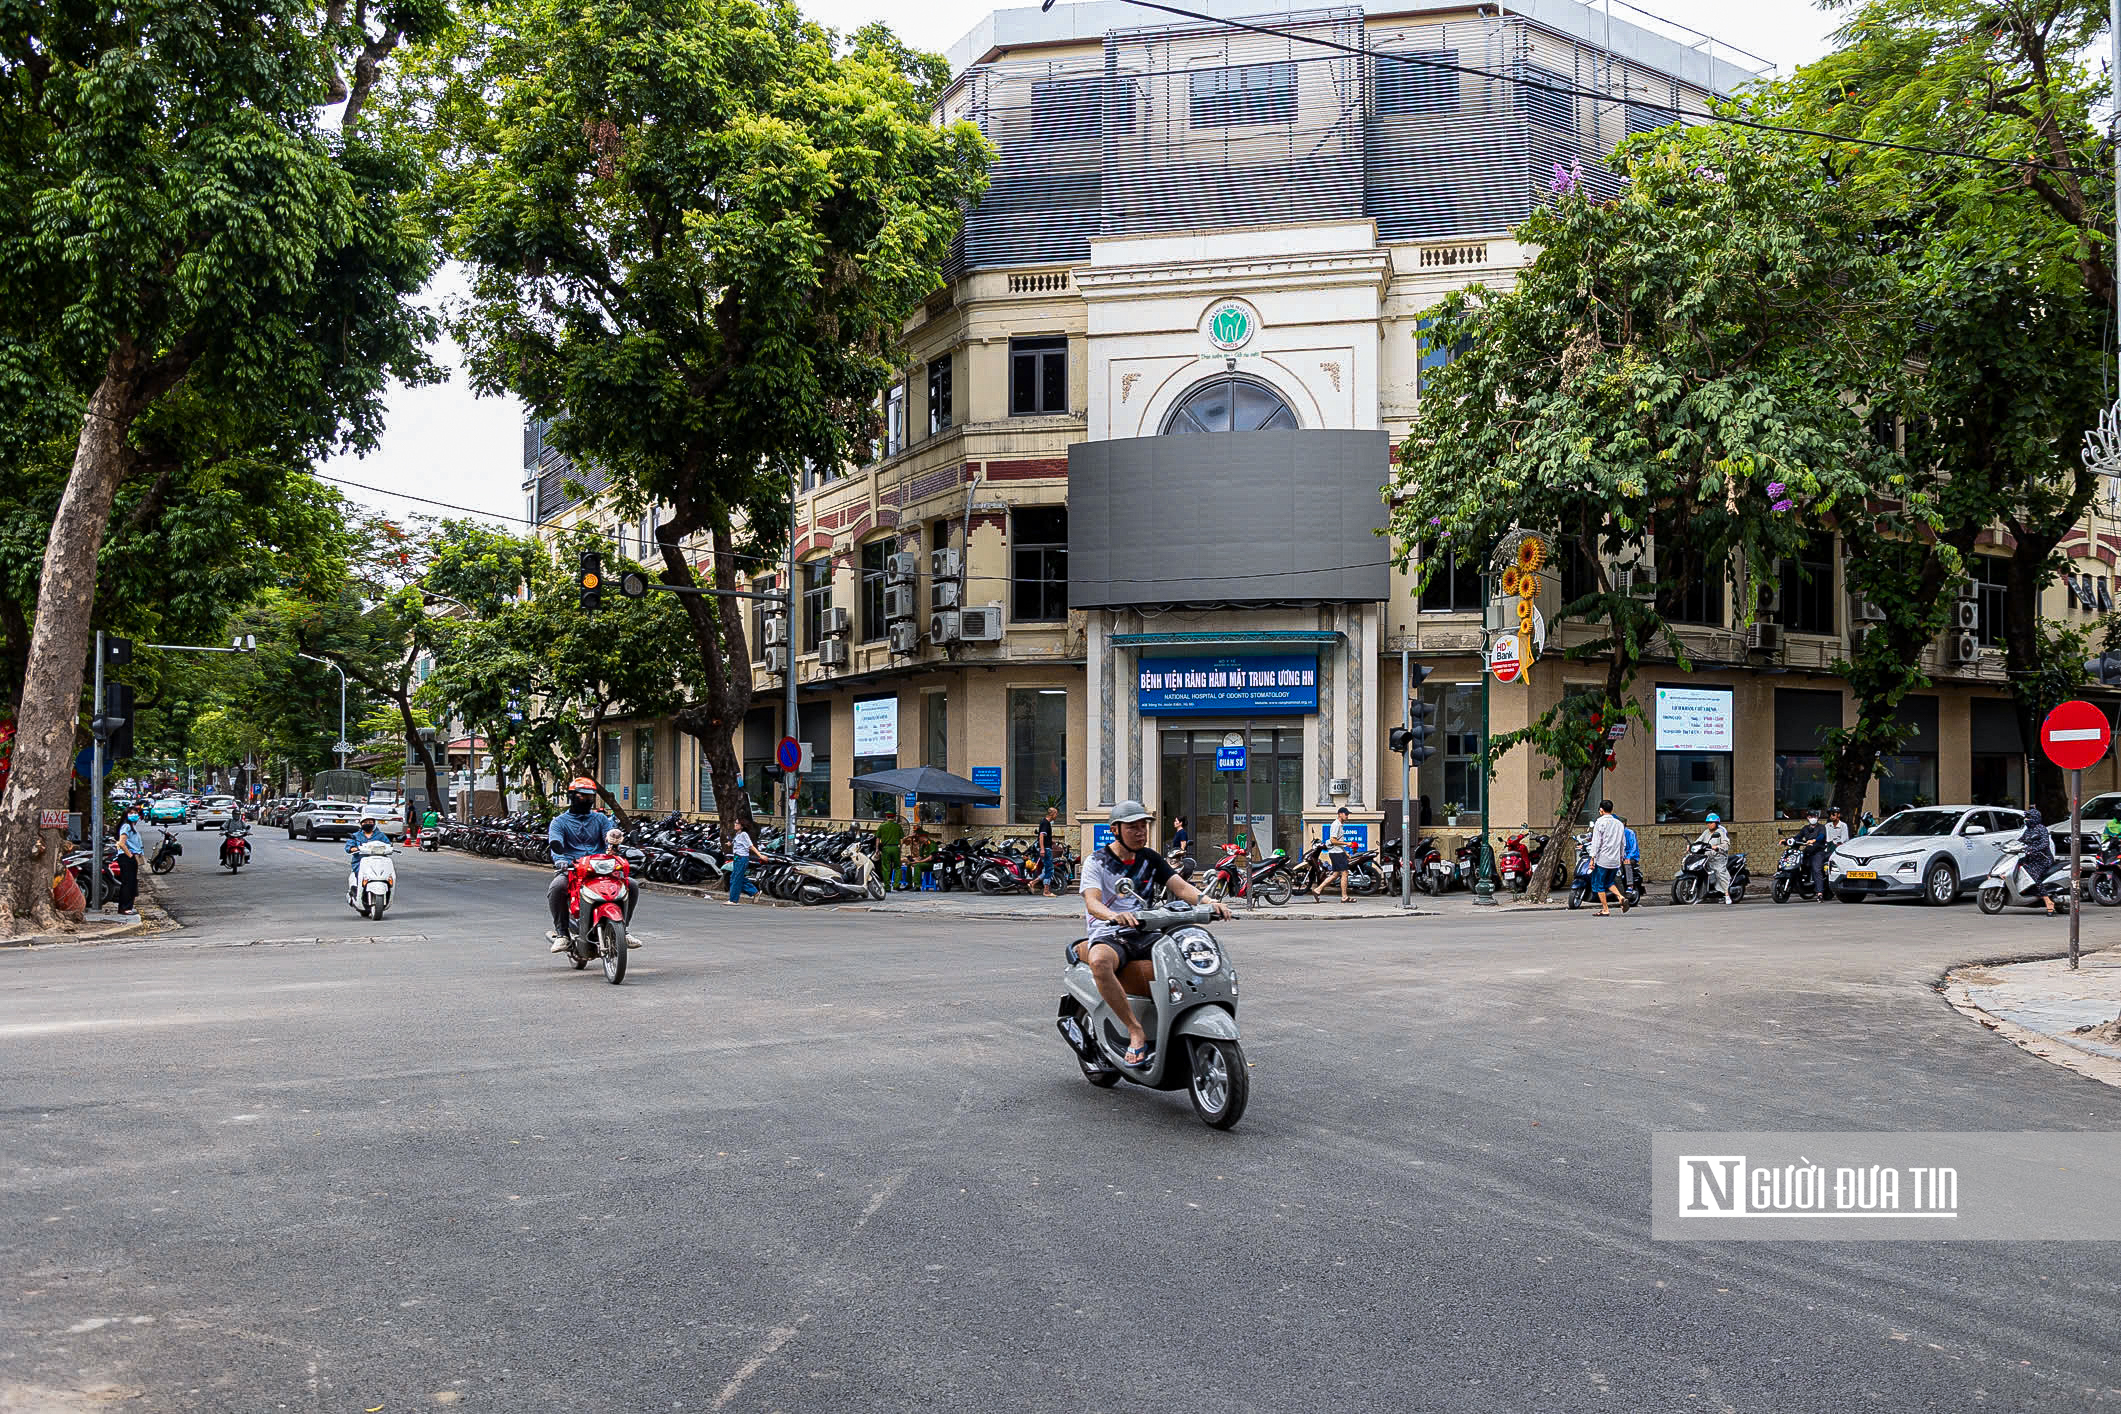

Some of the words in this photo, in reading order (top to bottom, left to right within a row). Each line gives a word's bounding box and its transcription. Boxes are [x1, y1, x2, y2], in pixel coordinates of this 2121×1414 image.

[1496, 643, 1506, 652] HD
[1496, 651, 1513, 660] Bank
[1141, 669, 1162, 692] BỆNH
[1164, 669, 1183, 692] VIỆN
[1185, 668, 1206, 688] RĂNG
[1209, 668, 1227, 688] HÀM
[1229, 668, 1246, 690] MẶT
[1249, 670, 1275, 687] TRUNG
[1278, 669, 1300, 686] ƯƠNG
[1302, 670, 1314, 686] HN
